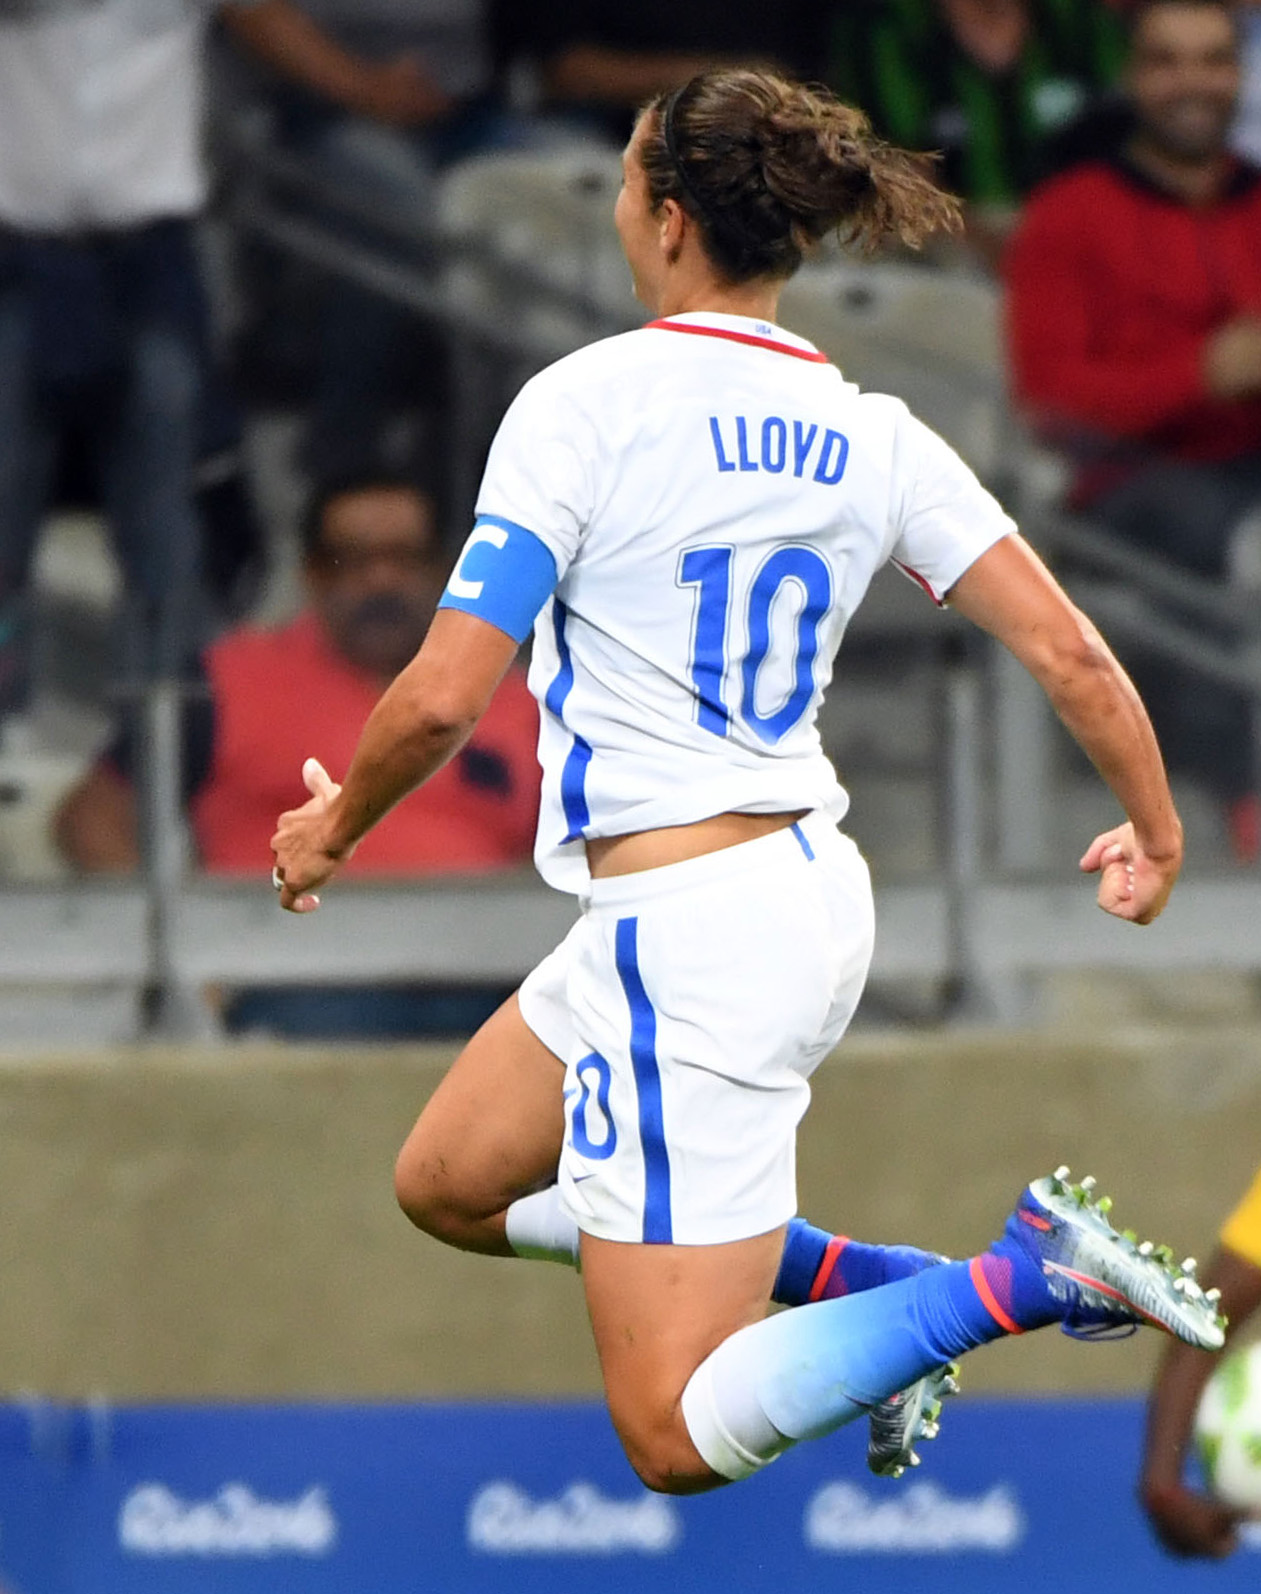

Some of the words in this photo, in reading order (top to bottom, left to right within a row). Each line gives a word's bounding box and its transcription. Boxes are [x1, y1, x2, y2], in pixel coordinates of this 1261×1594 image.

[709, 416, 849, 485] LLOYD
[447, 524, 509, 599] C
[676, 542, 834, 746] 10
[564, 1051, 617, 1161] 0
